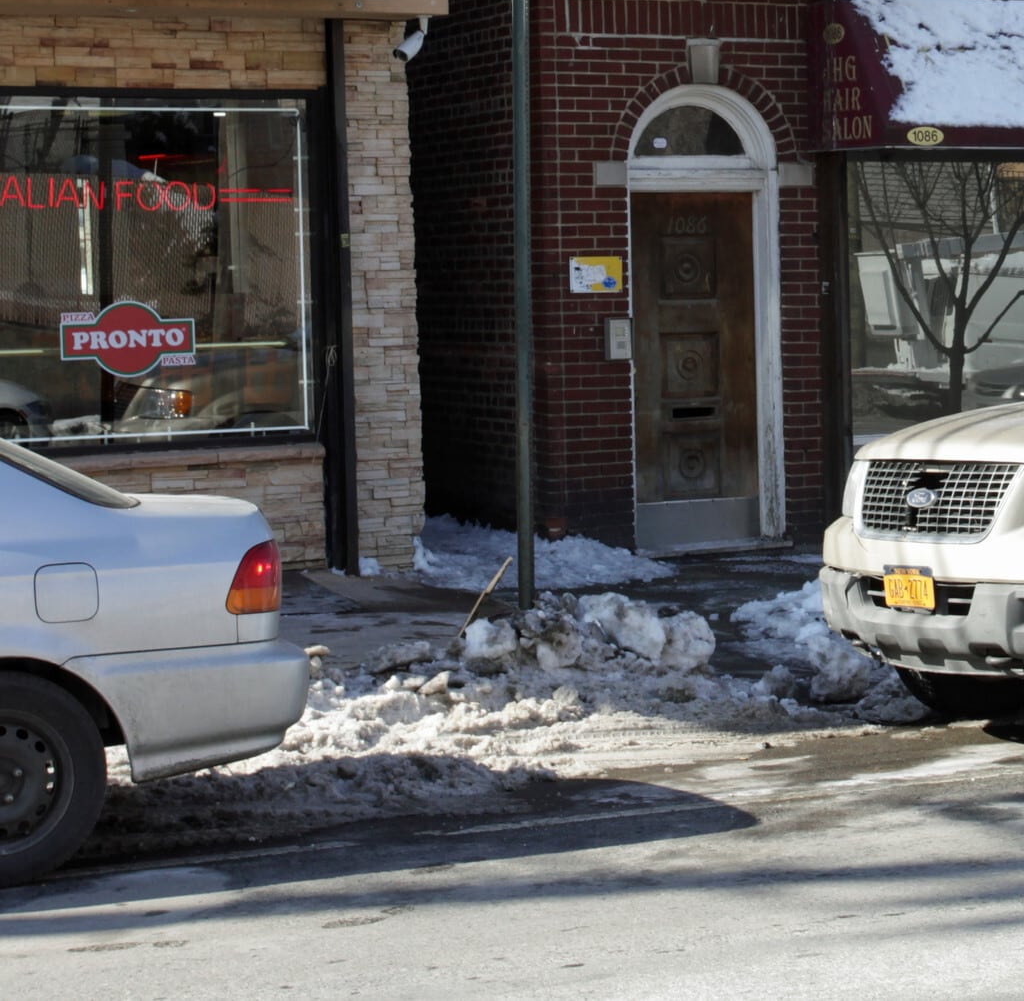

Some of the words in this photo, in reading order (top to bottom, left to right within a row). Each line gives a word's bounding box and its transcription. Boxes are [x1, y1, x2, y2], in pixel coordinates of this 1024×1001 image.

[912, 130, 939, 143] 1086
[0, 175, 105, 210] ALIAN
[114, 181, 217, 211] FOOD
[63, 313, 95, 323] PIZZA
[72, 327, 184, 351] PRONTO
[162, 357, 195, 366] PASTA
